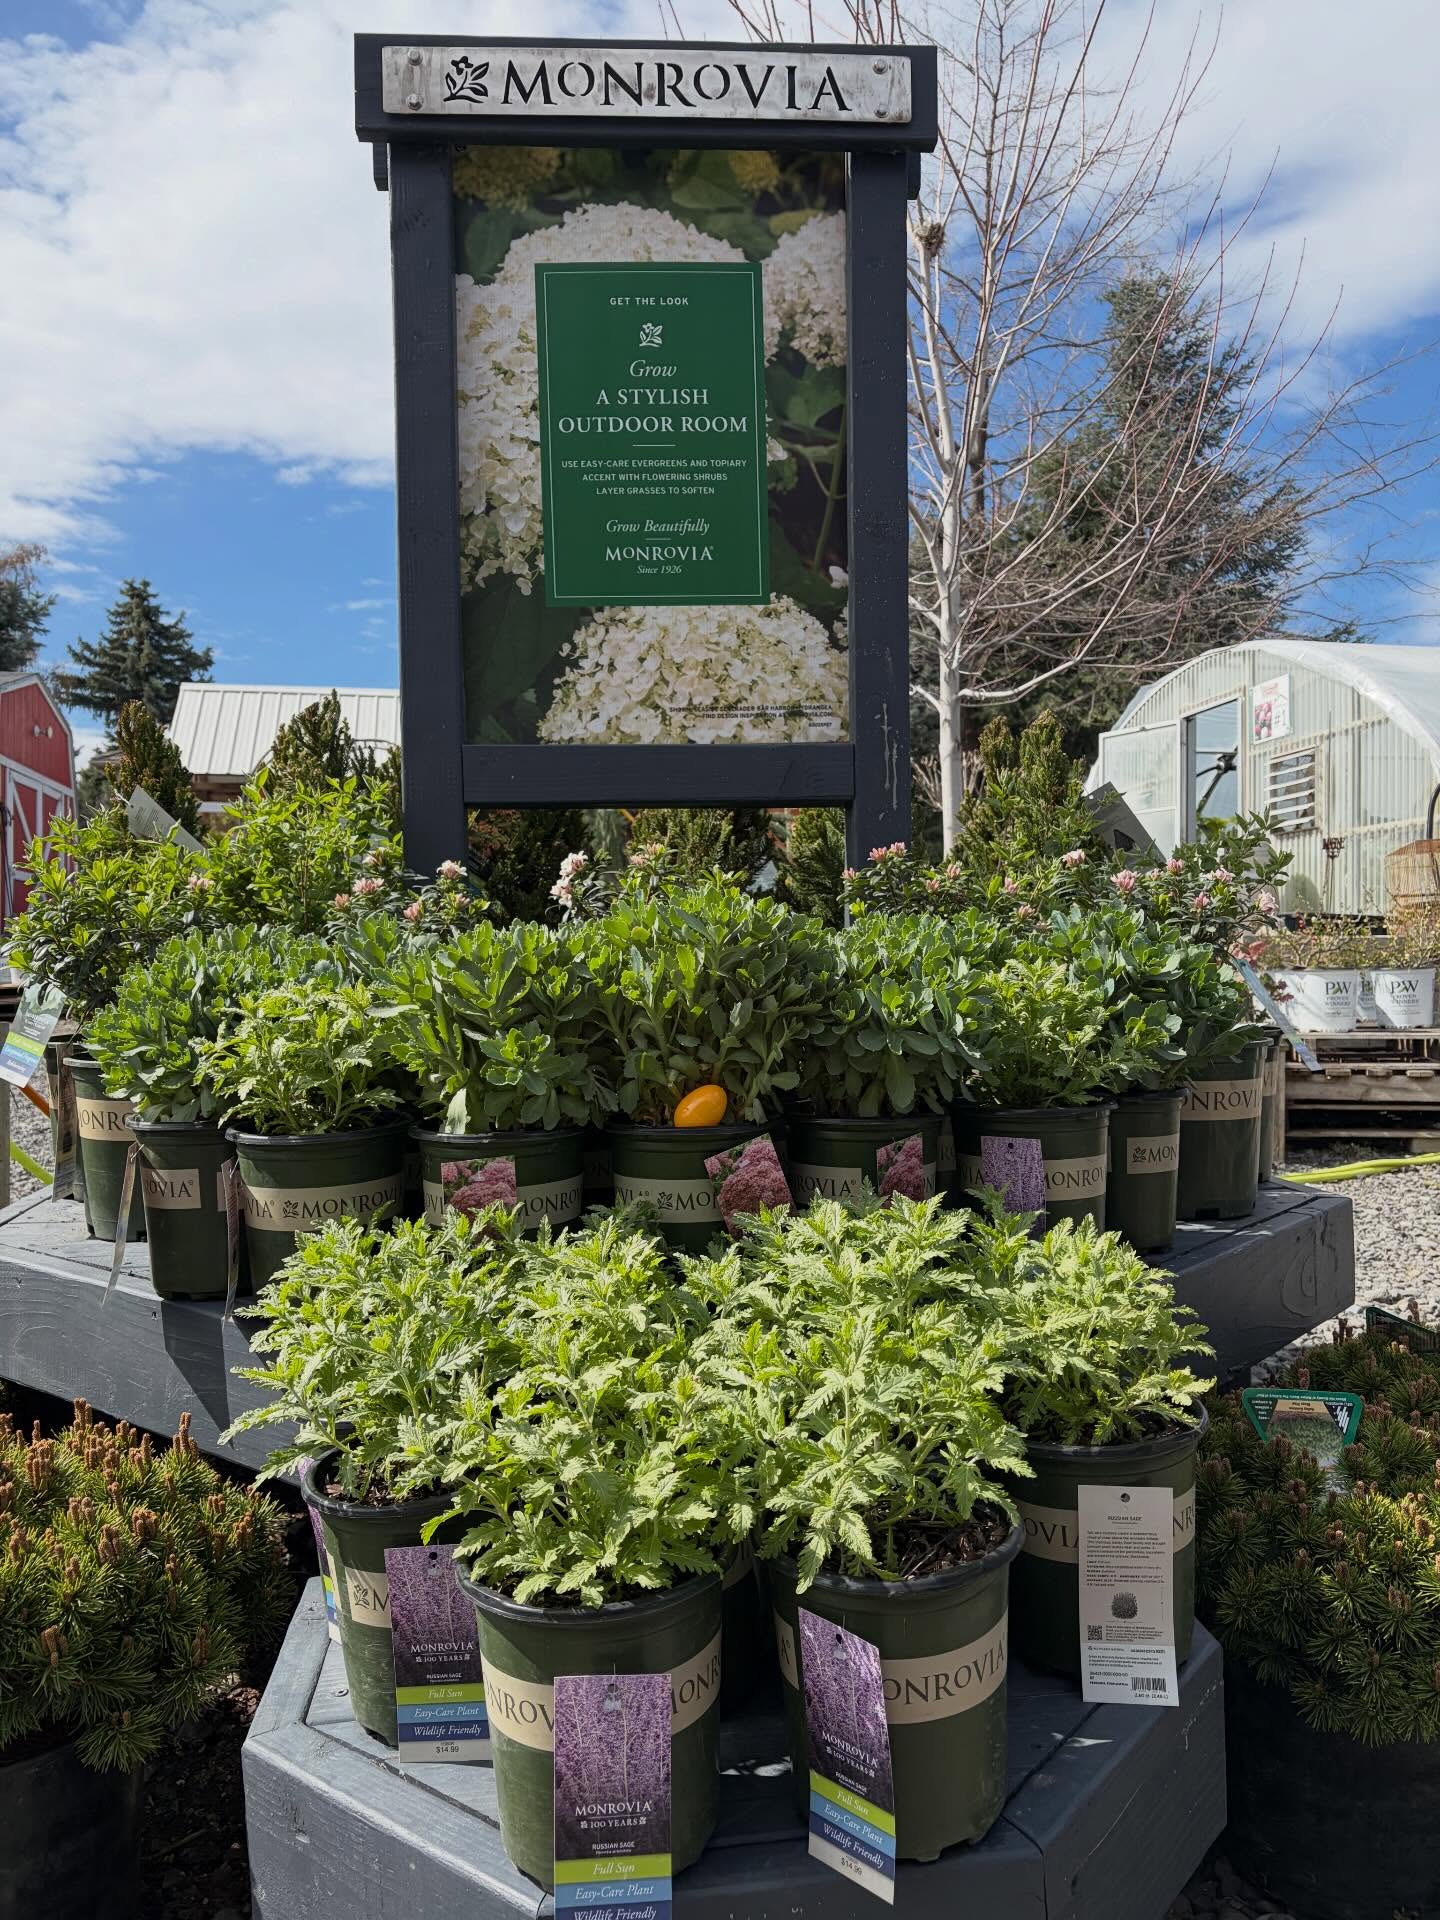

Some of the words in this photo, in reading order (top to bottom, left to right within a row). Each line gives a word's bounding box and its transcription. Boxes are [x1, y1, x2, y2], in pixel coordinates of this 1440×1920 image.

[500, 58, 853, 112] MONROVIA
[609, 297, 630, 306] GET
[635, 297, 656, 306] THE
[660, 297, 689, 306] LOOK
[630, 360, 677, 377] Grow
[596, 389, 611, 405] A
[617, 388, 709, 406] STYLISH
[558, 416, 674, 434] OUTDOOR
[681, 416, 748, 433] ROOM
[561, 460, 579, 468] USE
[580, 460, 630, 468] EASY-CARE
[632, 460, 688, 468] EVERGREENS
[693, 473, 728, 481] SHRUBS
[596, 487, 625, 495] LAYER
[626, 487, 666, 495] GRASSES
[682, 486, 715, 494] SOFTEN
[606, 519, 640, 532] Grow
[644, 518, 710, 536] Beautifully
[636, 564, 658, 574] Since
[660, 565, 682, 574] 1926
[438, 1654, 462, 1662] YEARS
[428, 1688, 445, 1699] Full
[446, 1688, 463, 1698] Sun
[414, 1707, 455, 1720] Easy-Care
[456, 1706, 479, 1716] Plant
[414, 1724, 446, 1738] Wildlife
[448, 1724, 482, 1737] Friendly
[436, 1746, 460, 1754] $14.99
[833, 1750, 845, 1762] 100
[846, 1756, 868, 1775] YEARS
[837, 1792, 854, 1806] Full
[854, 1799, 869, 1816] Sun
[590, 1820, 606, 1828] 100
[608, 1818, 638, 1828] YEARS
[824, 1804, 861, 1832] Easy-Care
[862, 1825, 884, 1845] Plant
[592, 1842, 618, 1850] RUSSIAN
[823, 1822, 852, 1848] Wildlife
[852, 1841, 884, 1869] Friendly
[593, 1862, 614, 1875] Full
[616, 1862, 635, 1873] Sun
[575, 1886, 624, 1903] Easy-Care
[626, 1883, 655, 1896] Plant
[574, 1908, 613, 1920] Wildlife
[616, 1906, 657, 1920] Friendly
